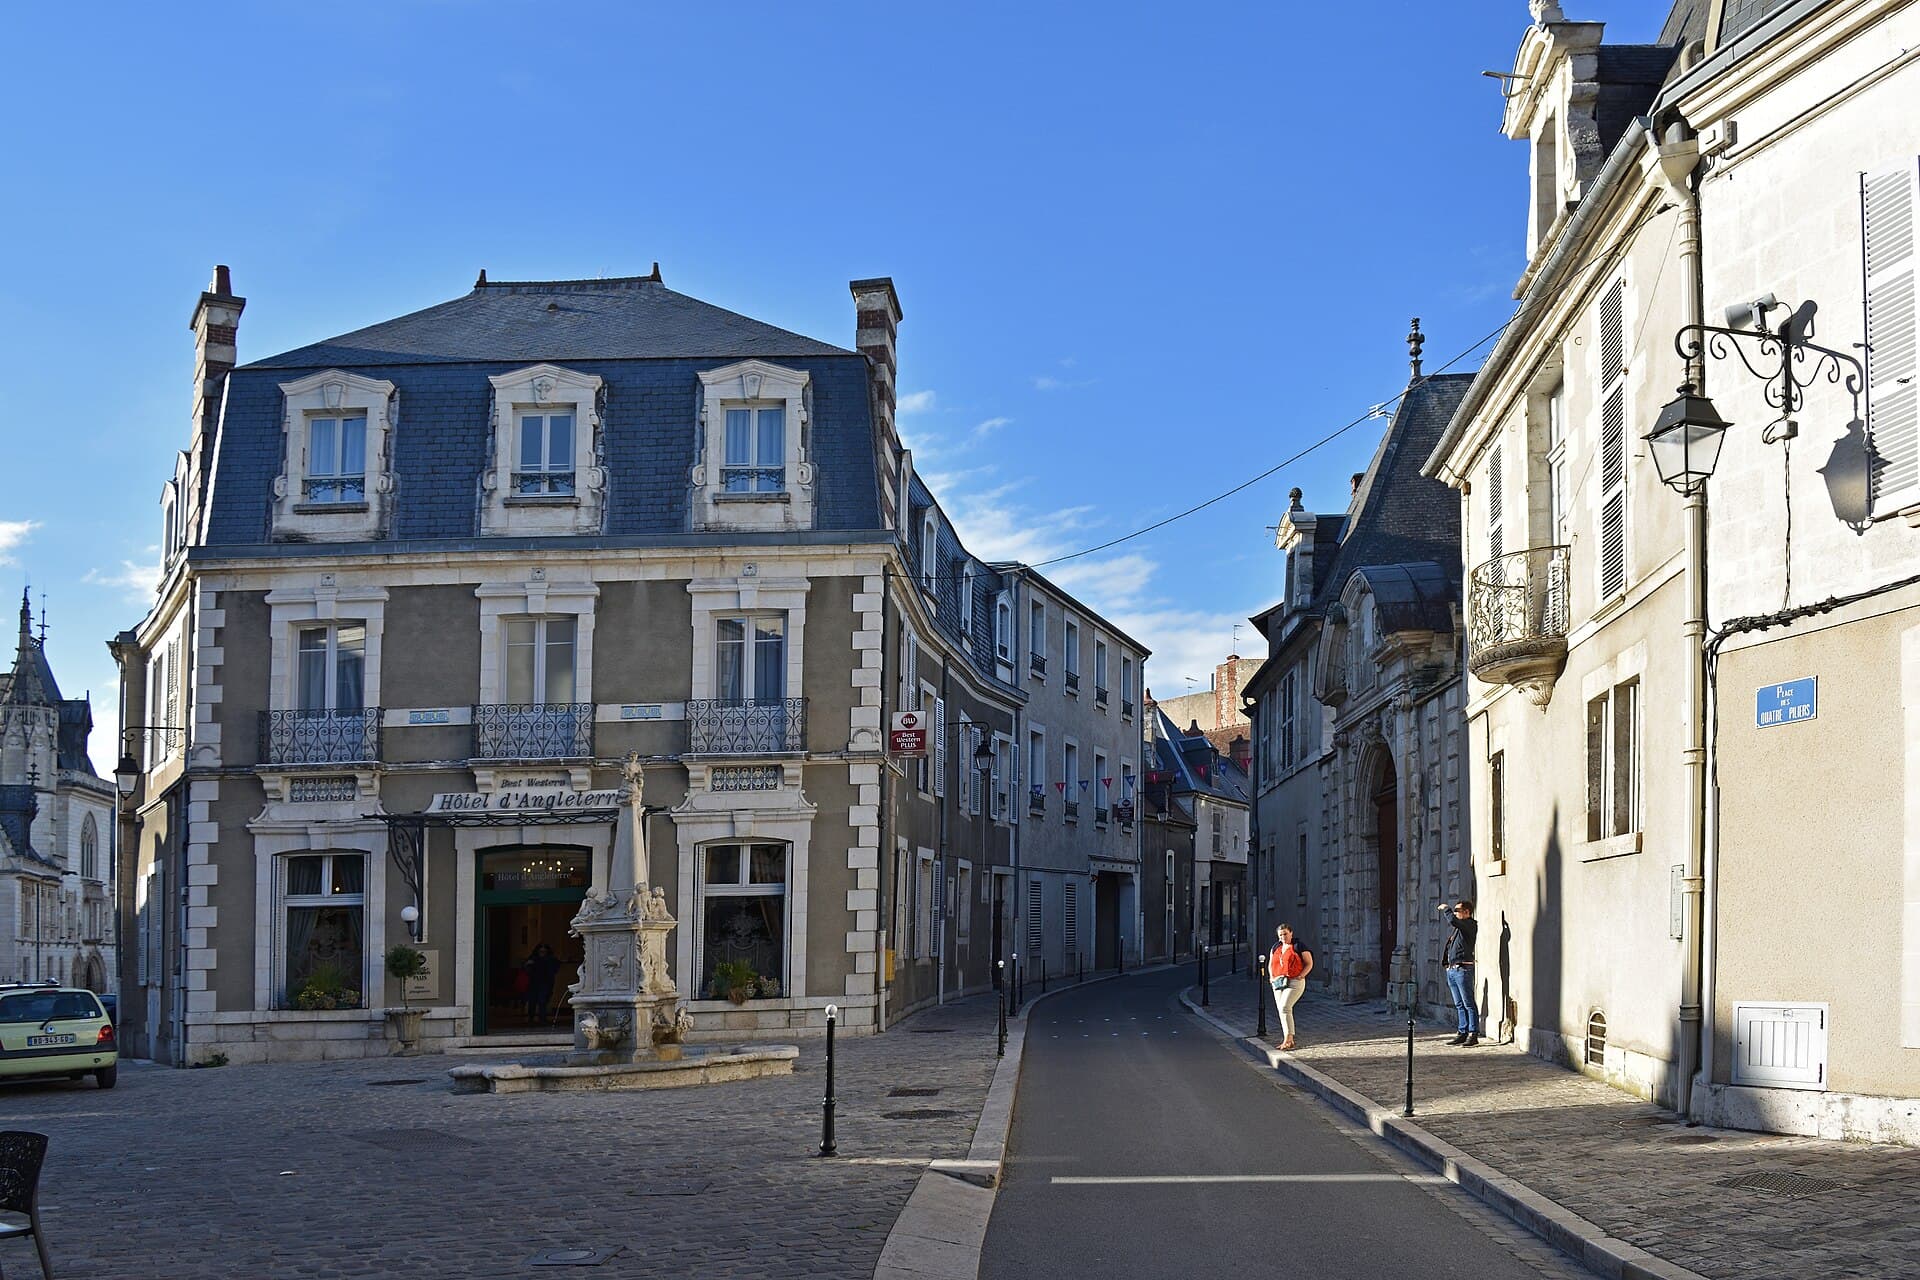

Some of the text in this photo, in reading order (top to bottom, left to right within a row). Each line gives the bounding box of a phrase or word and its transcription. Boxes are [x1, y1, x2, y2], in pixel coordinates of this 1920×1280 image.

[1761, 704, 1810, 724] QUATRE PILIERS
[500, 778, 566, 788] Best Western
[439, 794, 489, 809] Hôtel
